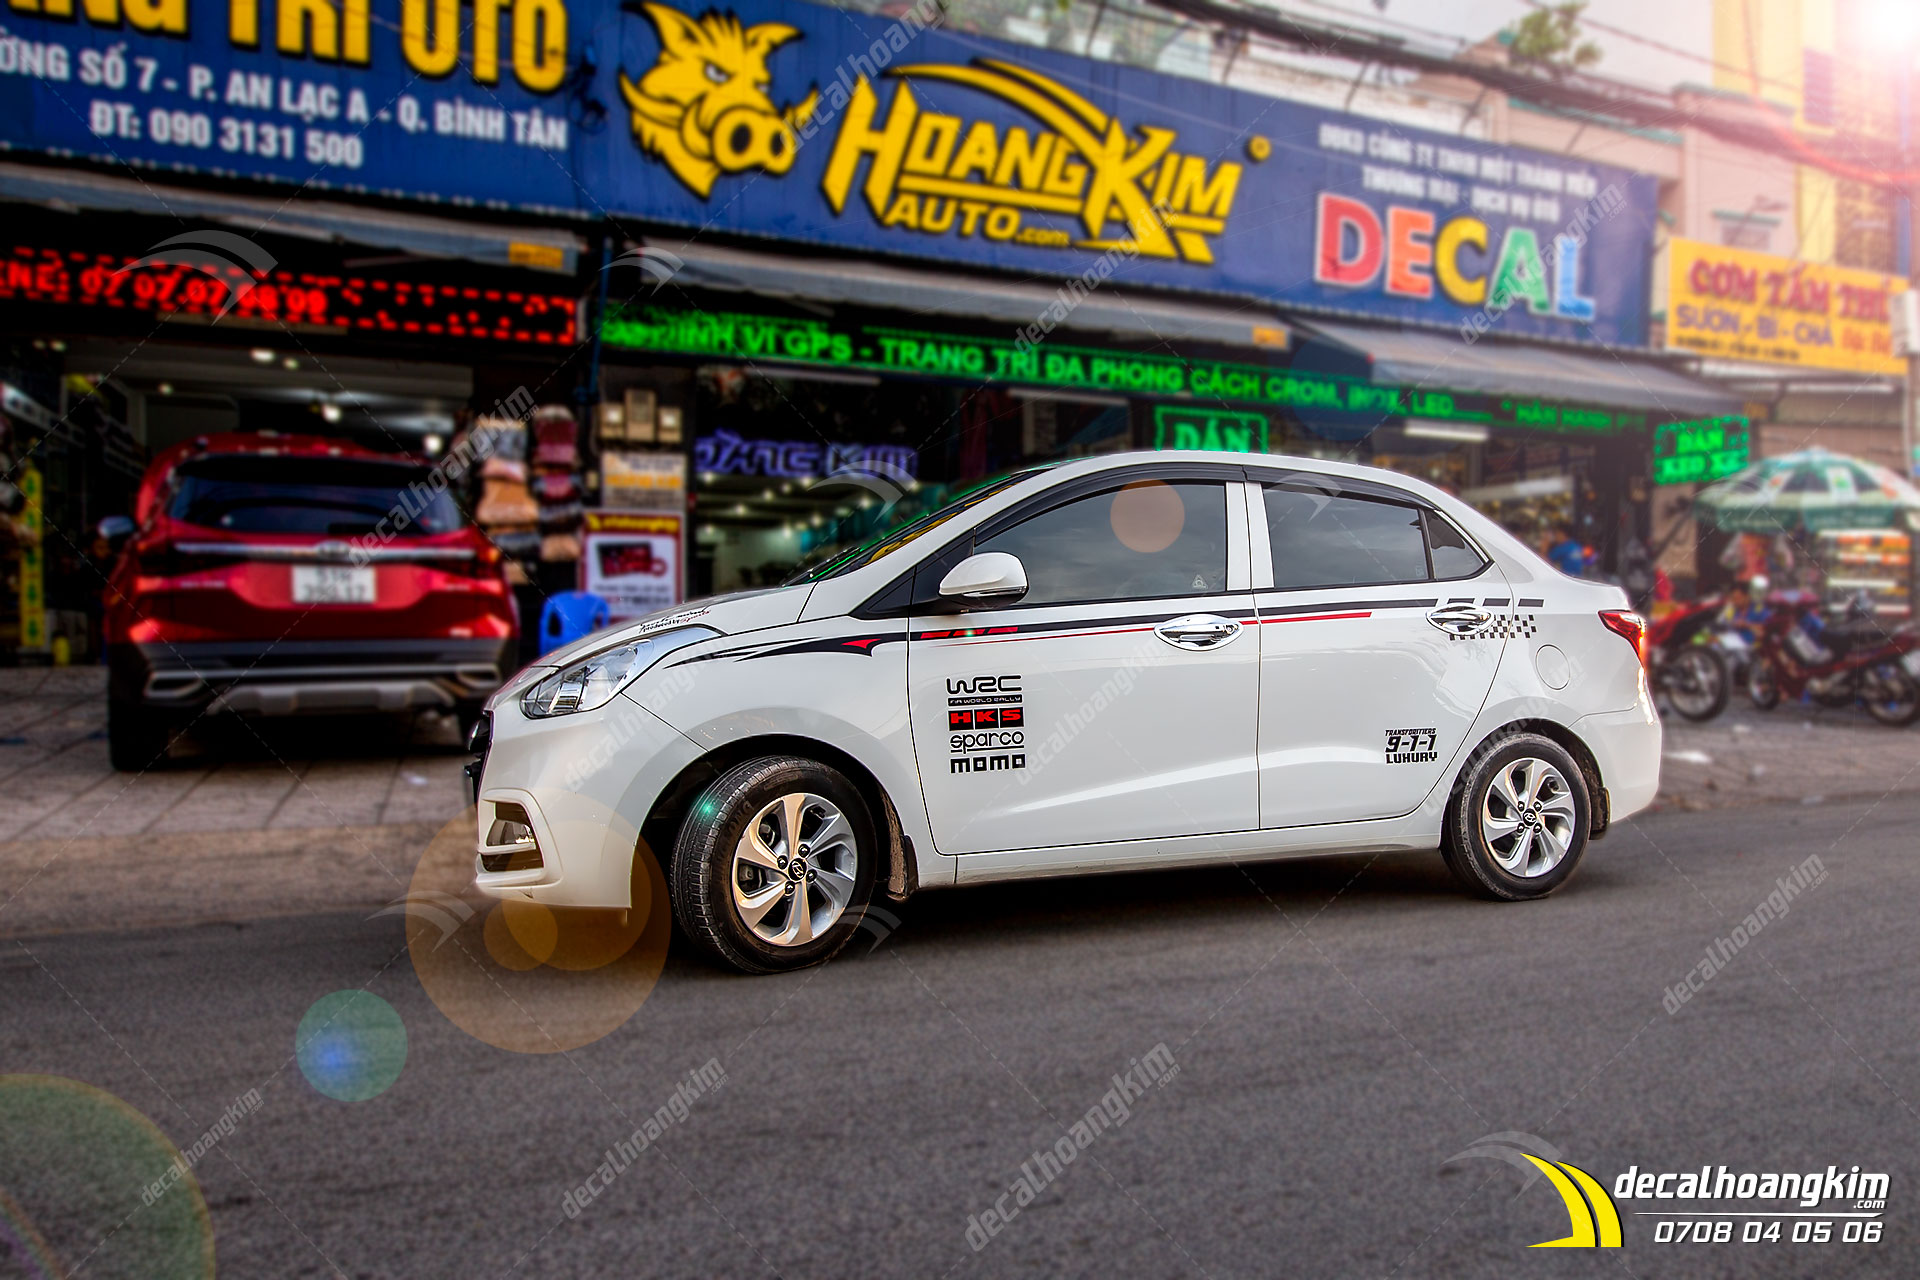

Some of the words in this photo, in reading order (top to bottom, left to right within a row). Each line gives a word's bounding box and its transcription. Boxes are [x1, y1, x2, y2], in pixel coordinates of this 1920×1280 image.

[79, 41, 127, 90] SỐ
[135, 57, 158, 92] 7
[188, 63, 217, 101] P.
[225, 69, 273, 110] AN
[280, 78, 339, 122] LẠC
[347, 88, 369, 123] A
[397, 95, 428, 133] Q.
[434, 97, 506, 141] BÌNH
[514, 107, 567, 150] TÂN
[150, 108, 212, 149] 090
[219, 116, 294, 160] 3131
[306, 129, 363, 168] 500
[1315, 193, 1596, 322] DECAL
[784, 329, 852, 362] GPS
[877, 337, 984, 373] TRANG
[1091, 358, 1183, 391] PHONG
[1190, 362, 1260, 399] CÁCH
[1174, 418, 1251, 453] DÁN
[946, 675, 1023, 695] WRC
[950, 708, 1021, 724] HKS
[950, 731, 1024, 754] sparco
